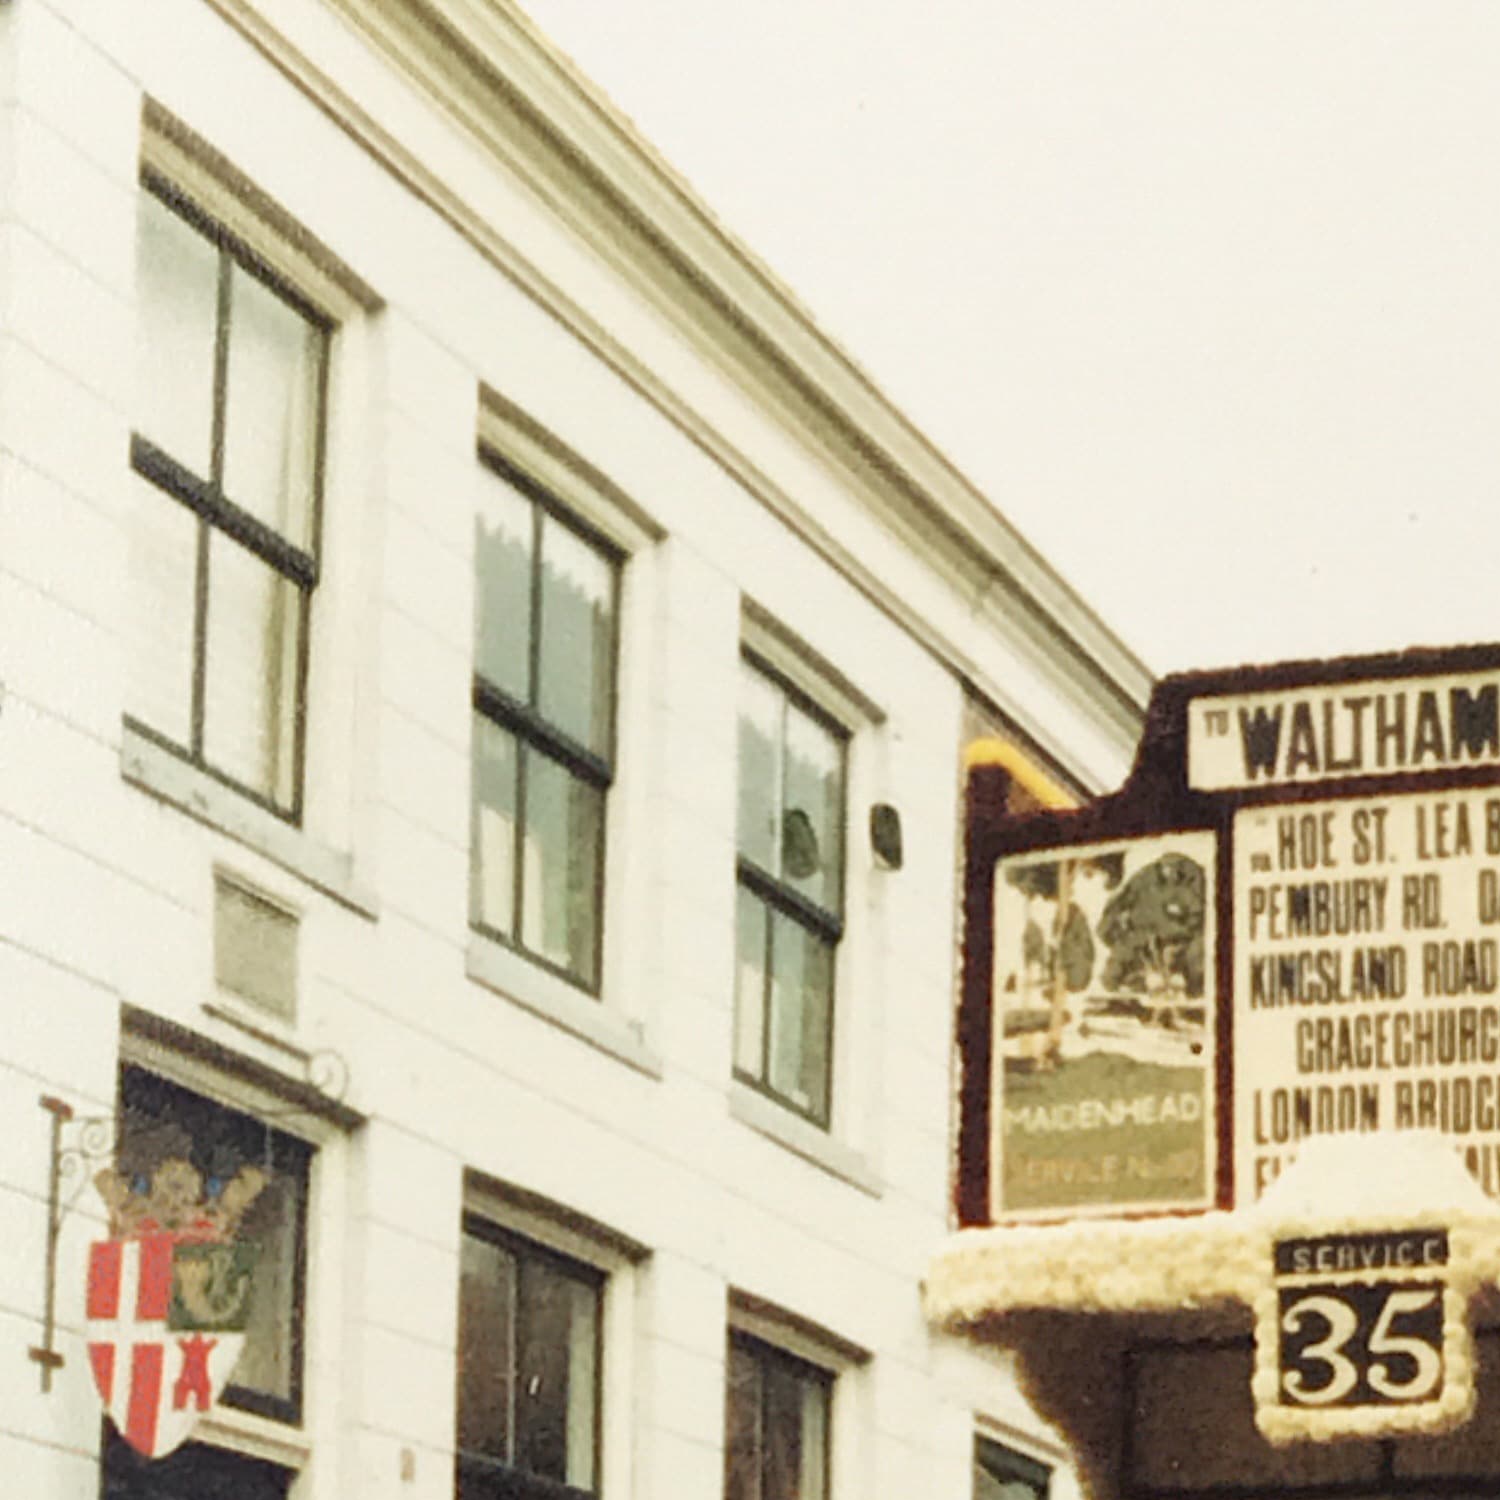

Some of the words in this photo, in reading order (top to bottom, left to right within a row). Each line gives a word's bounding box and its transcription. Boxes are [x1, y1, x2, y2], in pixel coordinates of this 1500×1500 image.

[1278, 810, 1338, 872] HOE
[1351, 807, 1397, 866] ST.
[1415, 802, 1471, 860] LEA
[1249, 876, 1389, 942] PEMBURY
[1402, 873, 1448, 931] RD.
[1250, 944, 1408, 1010] KINGSLAND
[1422, 939, 1498, 998] ROAD
[1002, 1091, 1200, 1134] MAIDENHEAD
[1254, 1082, 1380, 1146] LONDON
[1292, 1240, 1440, 1272] SERVICE
[1281, 1291, 1440, 1405] 35
